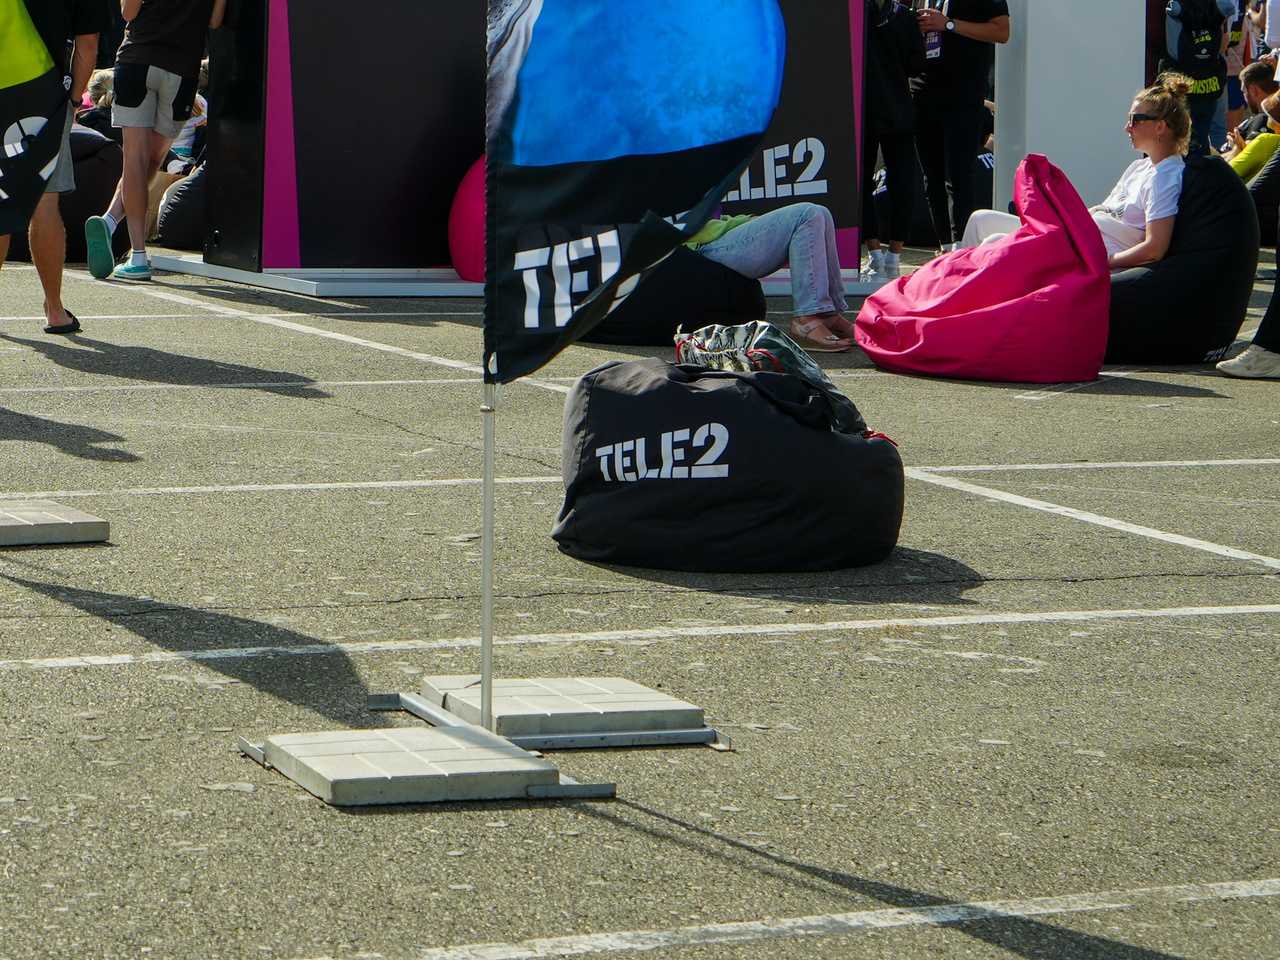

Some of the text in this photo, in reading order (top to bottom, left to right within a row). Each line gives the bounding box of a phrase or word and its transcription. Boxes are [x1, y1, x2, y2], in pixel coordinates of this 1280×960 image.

[1194, 34, 1212, 44] 226
[721, 137, 828, 203] LE2
[595, 422, 730, 482] TELE2
